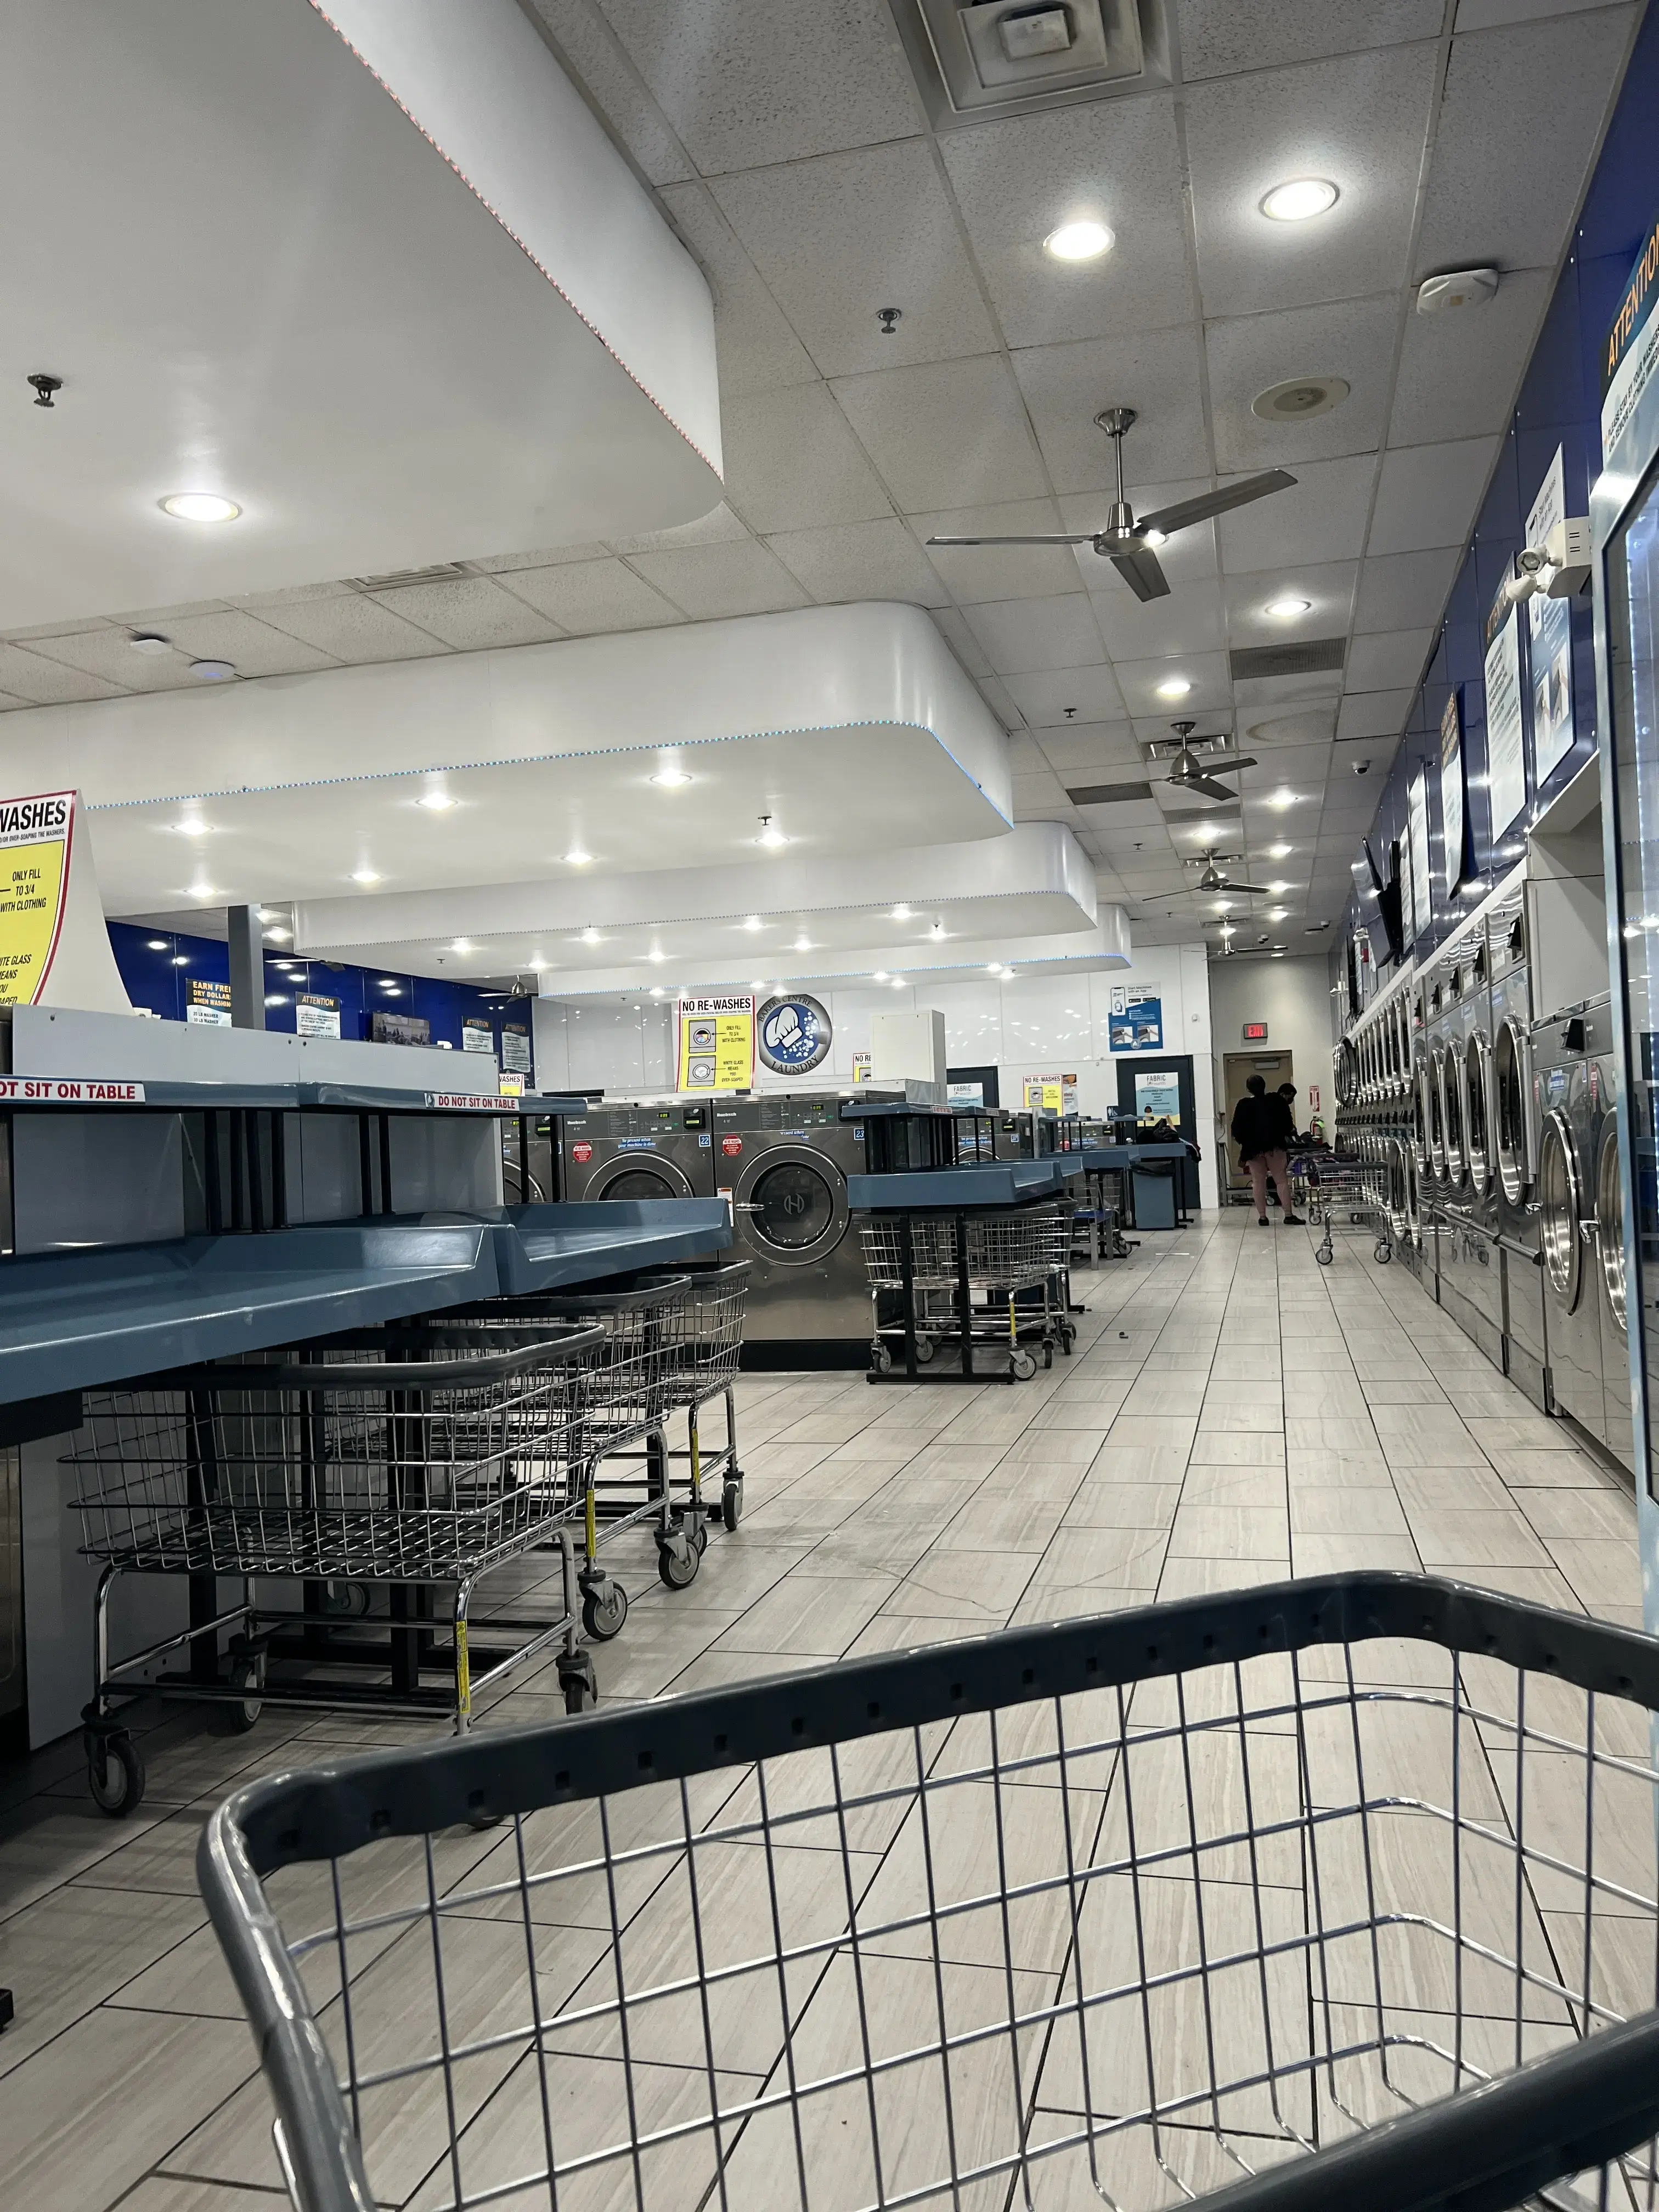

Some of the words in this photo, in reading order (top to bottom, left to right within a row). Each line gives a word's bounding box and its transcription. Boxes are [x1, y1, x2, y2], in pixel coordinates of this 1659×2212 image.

[13, 870, 27, 882] ONLY
[29, 868, 41, 879] FILL
[16, 885, 24, 896] TO
[25, 884, 35, 894] 3/4
[0, 901, 15, 912] WITH
[17, 897, 46, 911] CLOTHING
[11, 954, 32, 965] GLASS
[193, 981, 213, 990] EARN
[207, 991, 231, 1000] DOLLAR
[302, 995, 334, 1007] ATTENTION
[682, 1001, 695, 1012] NO
[698, 998, 751, 1011] RE-WASHES
[758, 998, 781, 1023] BAKERS
[782, 995, 812, 1007] CENTRE
[466, 1019, 489, 1028] ATTENTION
[505, 1024, 526, 1032] ATTENTION
[771, 1055, 820, 1074] LAUNDRY
[25, 1082, 52, 1097] SIT
[58, 1083, 81, 1098] ON
[87, 1084, 136, 1099] TABLE
[439, 1096, 449, 1106] DO
[452, 1097, 467, 1107] NOT
[469, 1097, 481, 1107] SIT
[482, 1098, 492, 1108] ON
[494, 1099, 515, 1109] TABLE
[701, 1137, 709, 1145] 22
